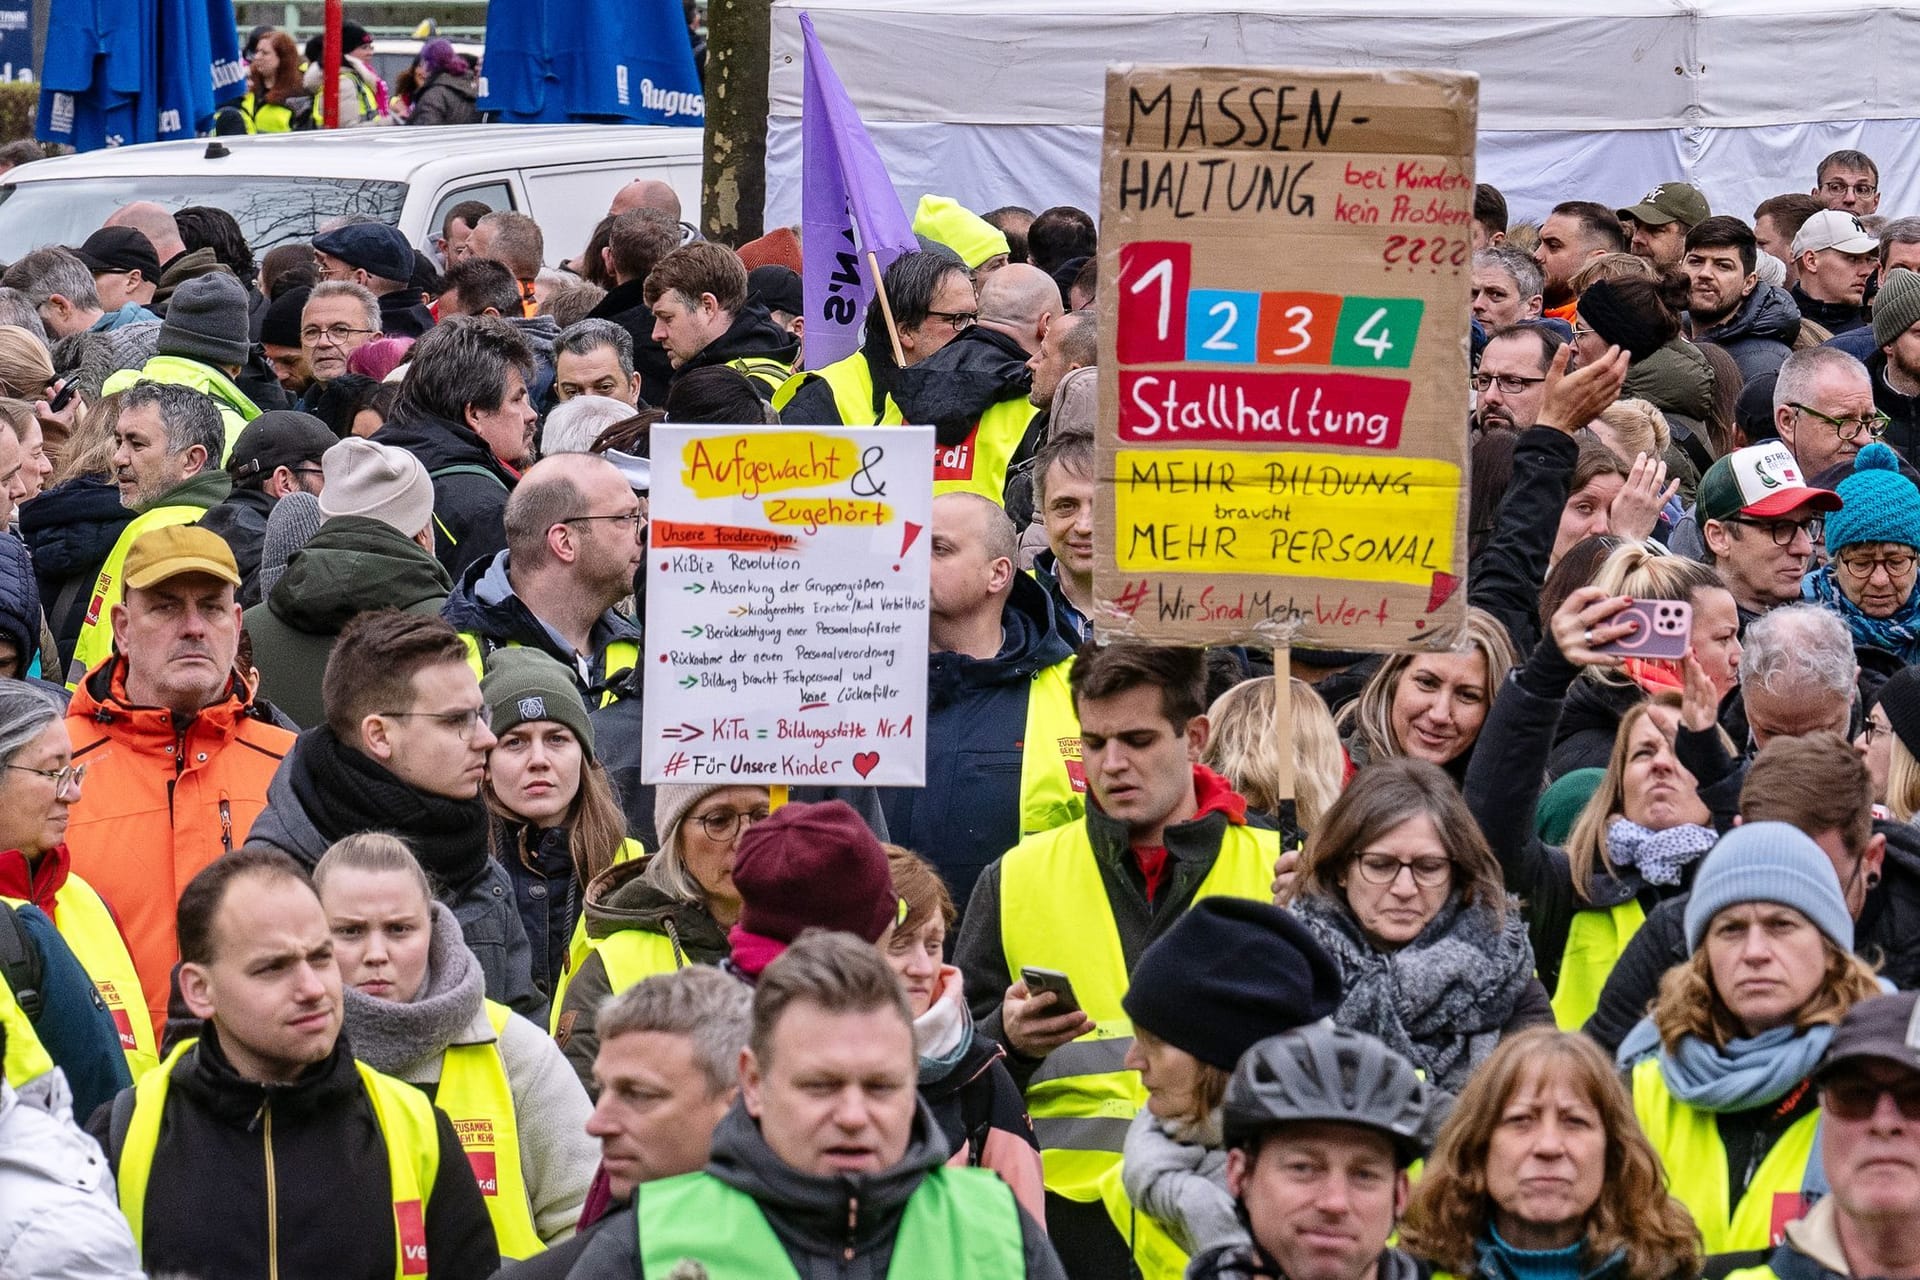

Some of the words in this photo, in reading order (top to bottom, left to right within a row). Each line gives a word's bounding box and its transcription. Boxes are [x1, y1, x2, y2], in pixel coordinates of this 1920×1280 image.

[640, 78, 704, 118] Augus
[1120, 159, 1314, 218] HALTUNG
[1345, 161, 1386, 190] bei
[1395, 161, 1471, 192] Kindern
[1335, 193, 1379, 224] kein
[1390, 194, 1471, 228] Problem
[1131, 258, 1172, 341] 1
[1201, 301, 1239, 350] 2
[1273, 305, 1313, 356] 3
[1353, 307, 1394, 360] 4
[1132, 376, 1389, 445] Stallhaltung
[690, 439, 840, 500] Aufgewacht
[851, 446, 886, 496] &
[1130, 461, 1235, 494] MEHR
[1264, 462, 1412, 497] BILDUNG
[1215, 502, 1291, 521] braucht
[661, 526, 704, 543] Unsere
[1128, 524, 1237, 560] MEHR
[1271, 528, 1437, 570] PERSONAL
[672, 553, 715, 574] KiBiz
[728, 553, 800, 571] Revolution
[710, 579, 775, 604] Absenkung
[780, 581, 801, 593] der
[804, 578, 885, 601] Gruppengrößen
[729, 649, 747, 664] der
[753, 653, 783, 664] neuen
[795, 645, 896, 667] Personalverordnung
[700, 671, 737, 692] Bildung
[742, 671, 778, 686] braucht
[783, 667, 843, 687] Fachpersonal
[853, 665, 872, 681] und
[800, 687, 827, 703] keine
[712, 718, 749, 741] KiTa
[777, 718, 867, 749] Bildungsstätte
[458, 1133, 475, 1143] EHT
